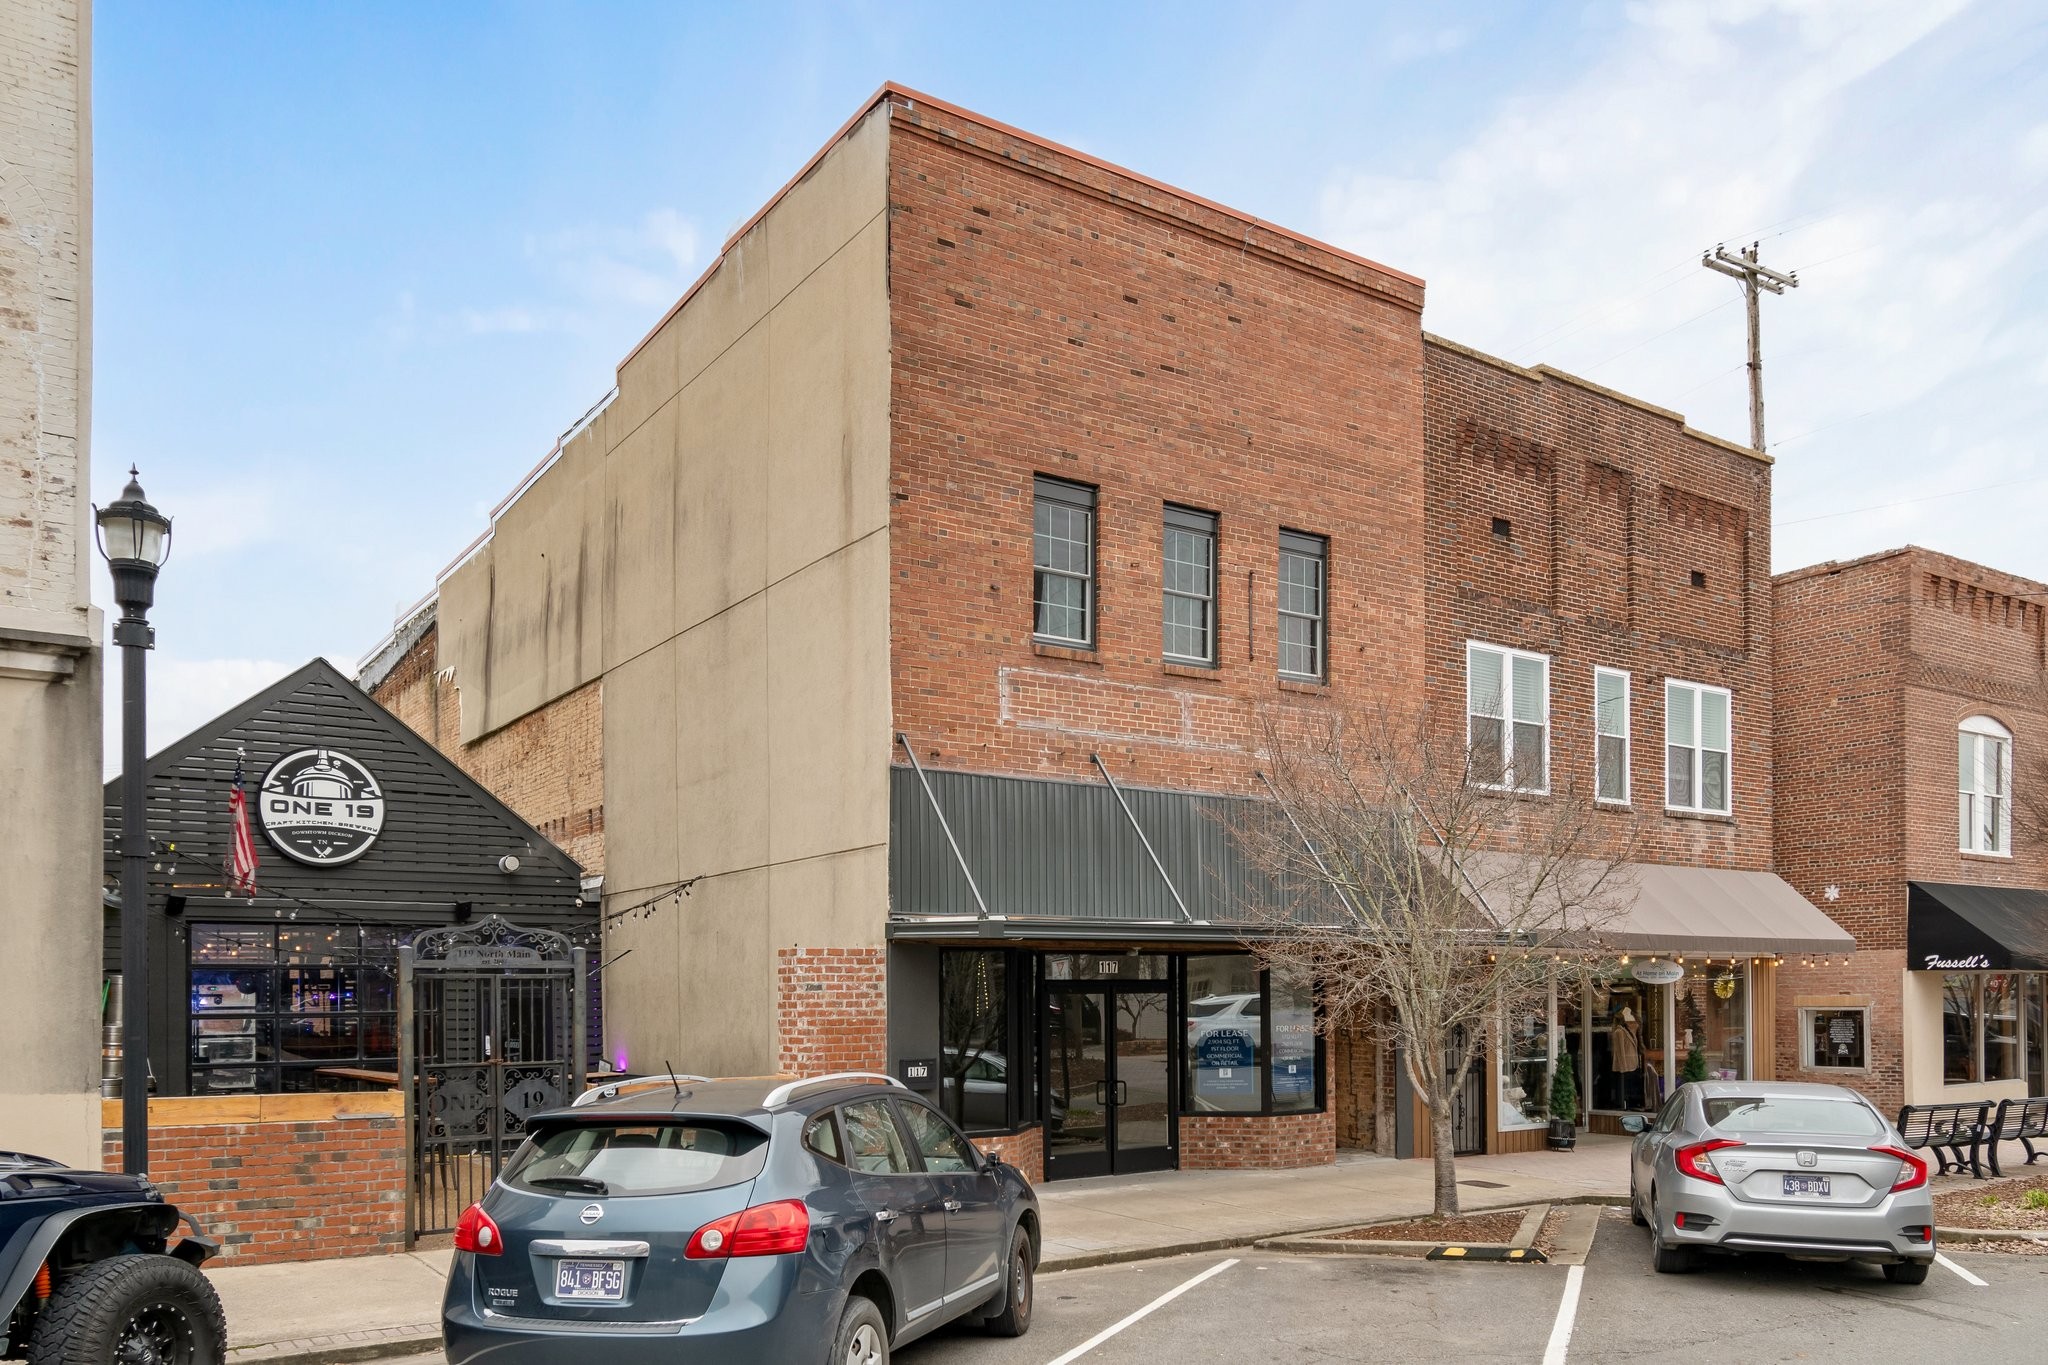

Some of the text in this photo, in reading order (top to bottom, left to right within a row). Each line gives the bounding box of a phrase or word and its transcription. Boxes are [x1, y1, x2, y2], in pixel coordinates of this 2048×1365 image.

[270, 799, 374, 818] ONE 19
[338, 822, 378, 832] BREWERY
[328, 830, 353, 838] DICKSON
[458, 950, 531, 959] 119 North Main
[1099, 960, 1119, 973] 117
[1924, 954, 1990, 970] Fussell's
[908, 1066, 927, 1077] 117
[428, 1093, 483, 1112] ONE
[522, 1090, 544, 1109] 19
[1784, 1179, 1829, 1192] 438 BDXV
[560, 1269, 620, 1289] 841 BFSG
[488, 1287, 518, 1297] ROGUE
